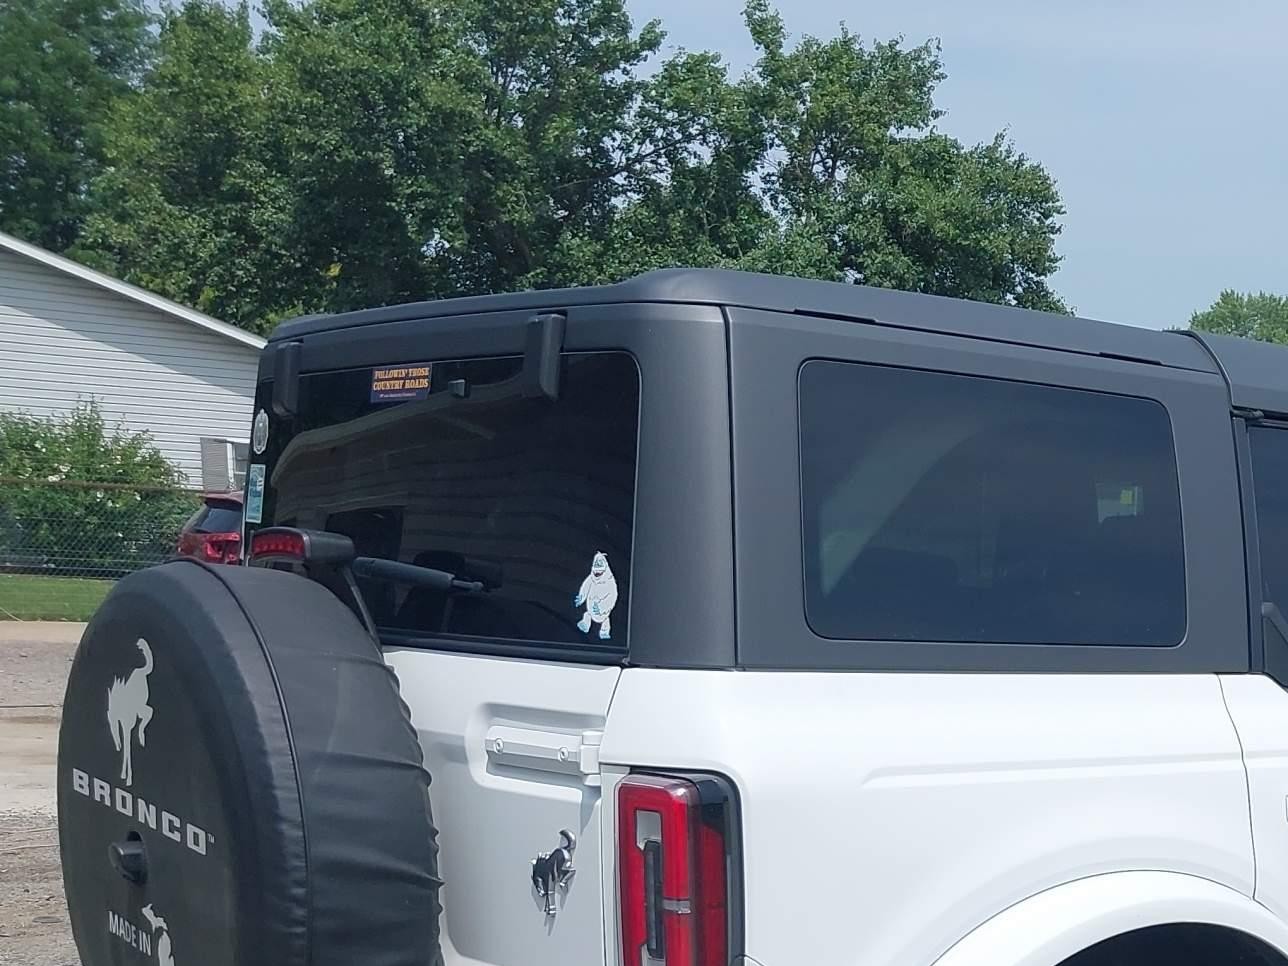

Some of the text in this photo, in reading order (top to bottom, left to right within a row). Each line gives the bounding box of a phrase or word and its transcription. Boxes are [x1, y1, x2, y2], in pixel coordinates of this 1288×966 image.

[373, 378, 429, 390] COUNTRY ROADS
[108, 910, 152, 957] MADE IN
